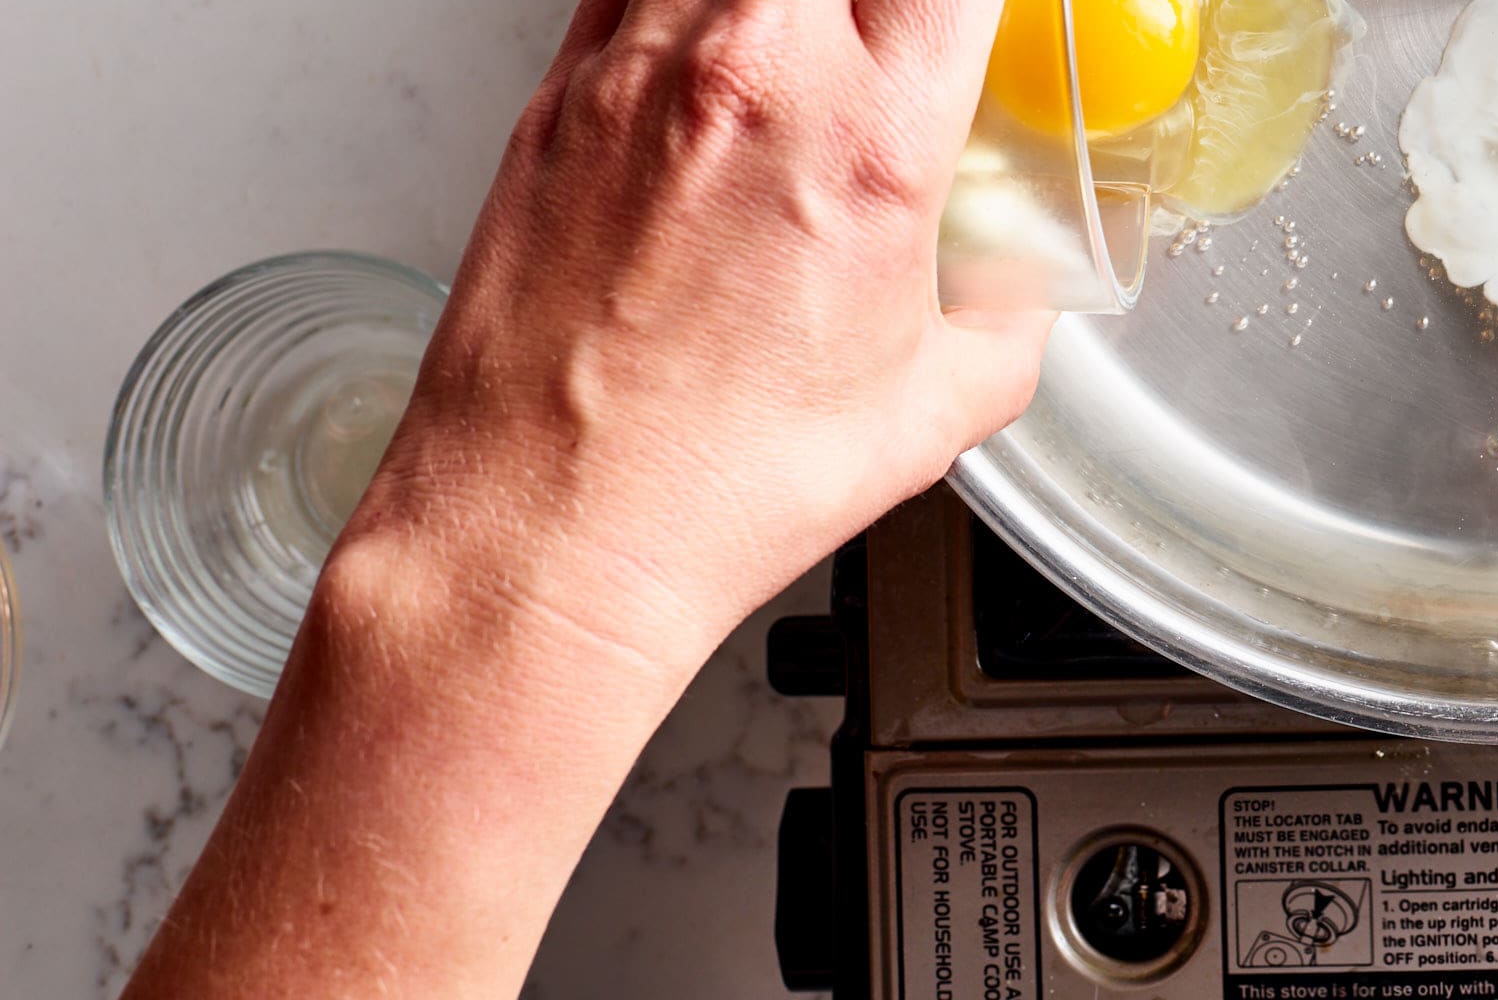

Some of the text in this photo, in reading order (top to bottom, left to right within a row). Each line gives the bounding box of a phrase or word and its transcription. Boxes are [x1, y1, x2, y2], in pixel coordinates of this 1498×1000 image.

[1233, 800, 1275, 812] STOP!
[911, 802, 928, 843] USE.
[931, 802, 949, 839] NOT
[1234, 813, 1363, 827] THE LOCATOR TAB
[1376, 819, 1399, 835] To
[1403, 818, 1452, 834] avoid
[958, 801, 976, 866] STOVE.
[1234, 828, 1370, 843] MUST BE ENGAGED
[1234, 844, 1372, 858] WITH THE NOTCH IN
[1377, 839, 1464, 856] additional
[932, 846, 949, 883] FOR
[1235, 860, 1371, 874] CANISTER COLLAR.
[979, 801, 999, 958] PORTABLE CAMP
[1380, 869, 1456, 889] Lighting
[1463, 867, 1498, 885] and
[1001, 801, 1021, 980] FOR OUTDOOR USE
[1382, 900, 1394, 912] 1.
[1398, 898, 1438, 915] Open
[1382, 917, 1396, 930] in
[1400, 917, 1424, 930] the
[1427, 918, 1446, 932] up
[1450, 915, 1484, 931] right
[1382, 935, 1406, 948] the
[1410, 933, 1478, 947] IGNITION
[1382, 952, 1414, 966] OFF
[1418, 951, 1481, 967] position.
[1484, 950, 1498, 963] 6.
[1239, 984, 1275, 998] This
[1281, 985, 1327, 998] stove
[1352, 983, 1376, 997] for
[1382, 985, 1412, 996] use
[1418, 981, 1453, 998] only
[1459, 980, 1494, 994] with
